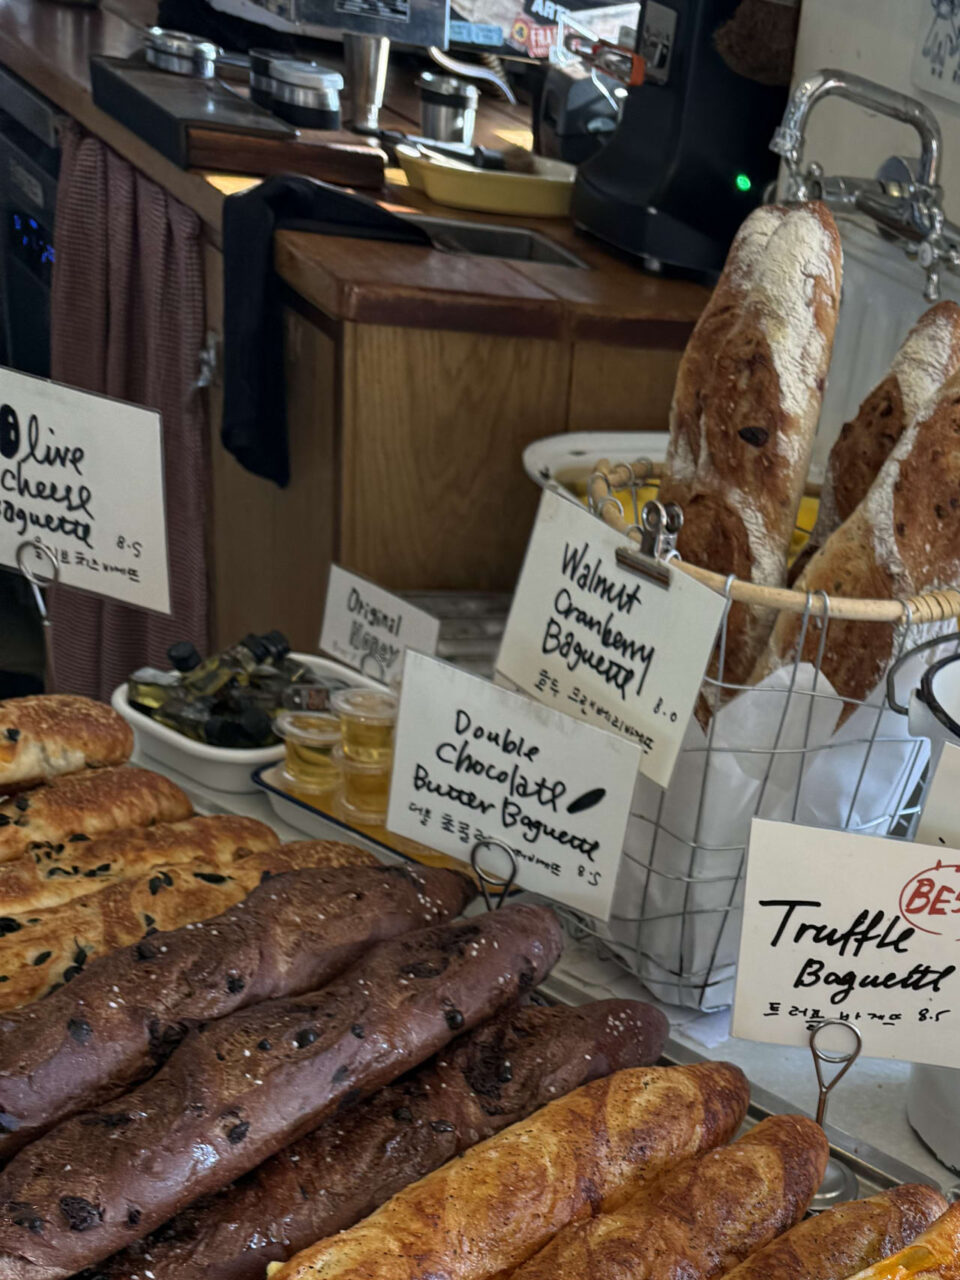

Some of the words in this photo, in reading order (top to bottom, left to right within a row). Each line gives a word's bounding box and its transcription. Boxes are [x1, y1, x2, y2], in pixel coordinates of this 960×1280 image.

[0, 500, 94, 549] aguette
[561, 542, 642, 614] Walnut
[542, 617, 636, 701] Baguette
[455, 709, 540, 762] Double
[414, 763, 495, 815] Butter
[501, 796, 601, 862] Baguette
[758, 899, 916, 957] Truffle
[793, 958, 957, 1005] Baguette
[917, 1007, 951, 1023] 8.5
